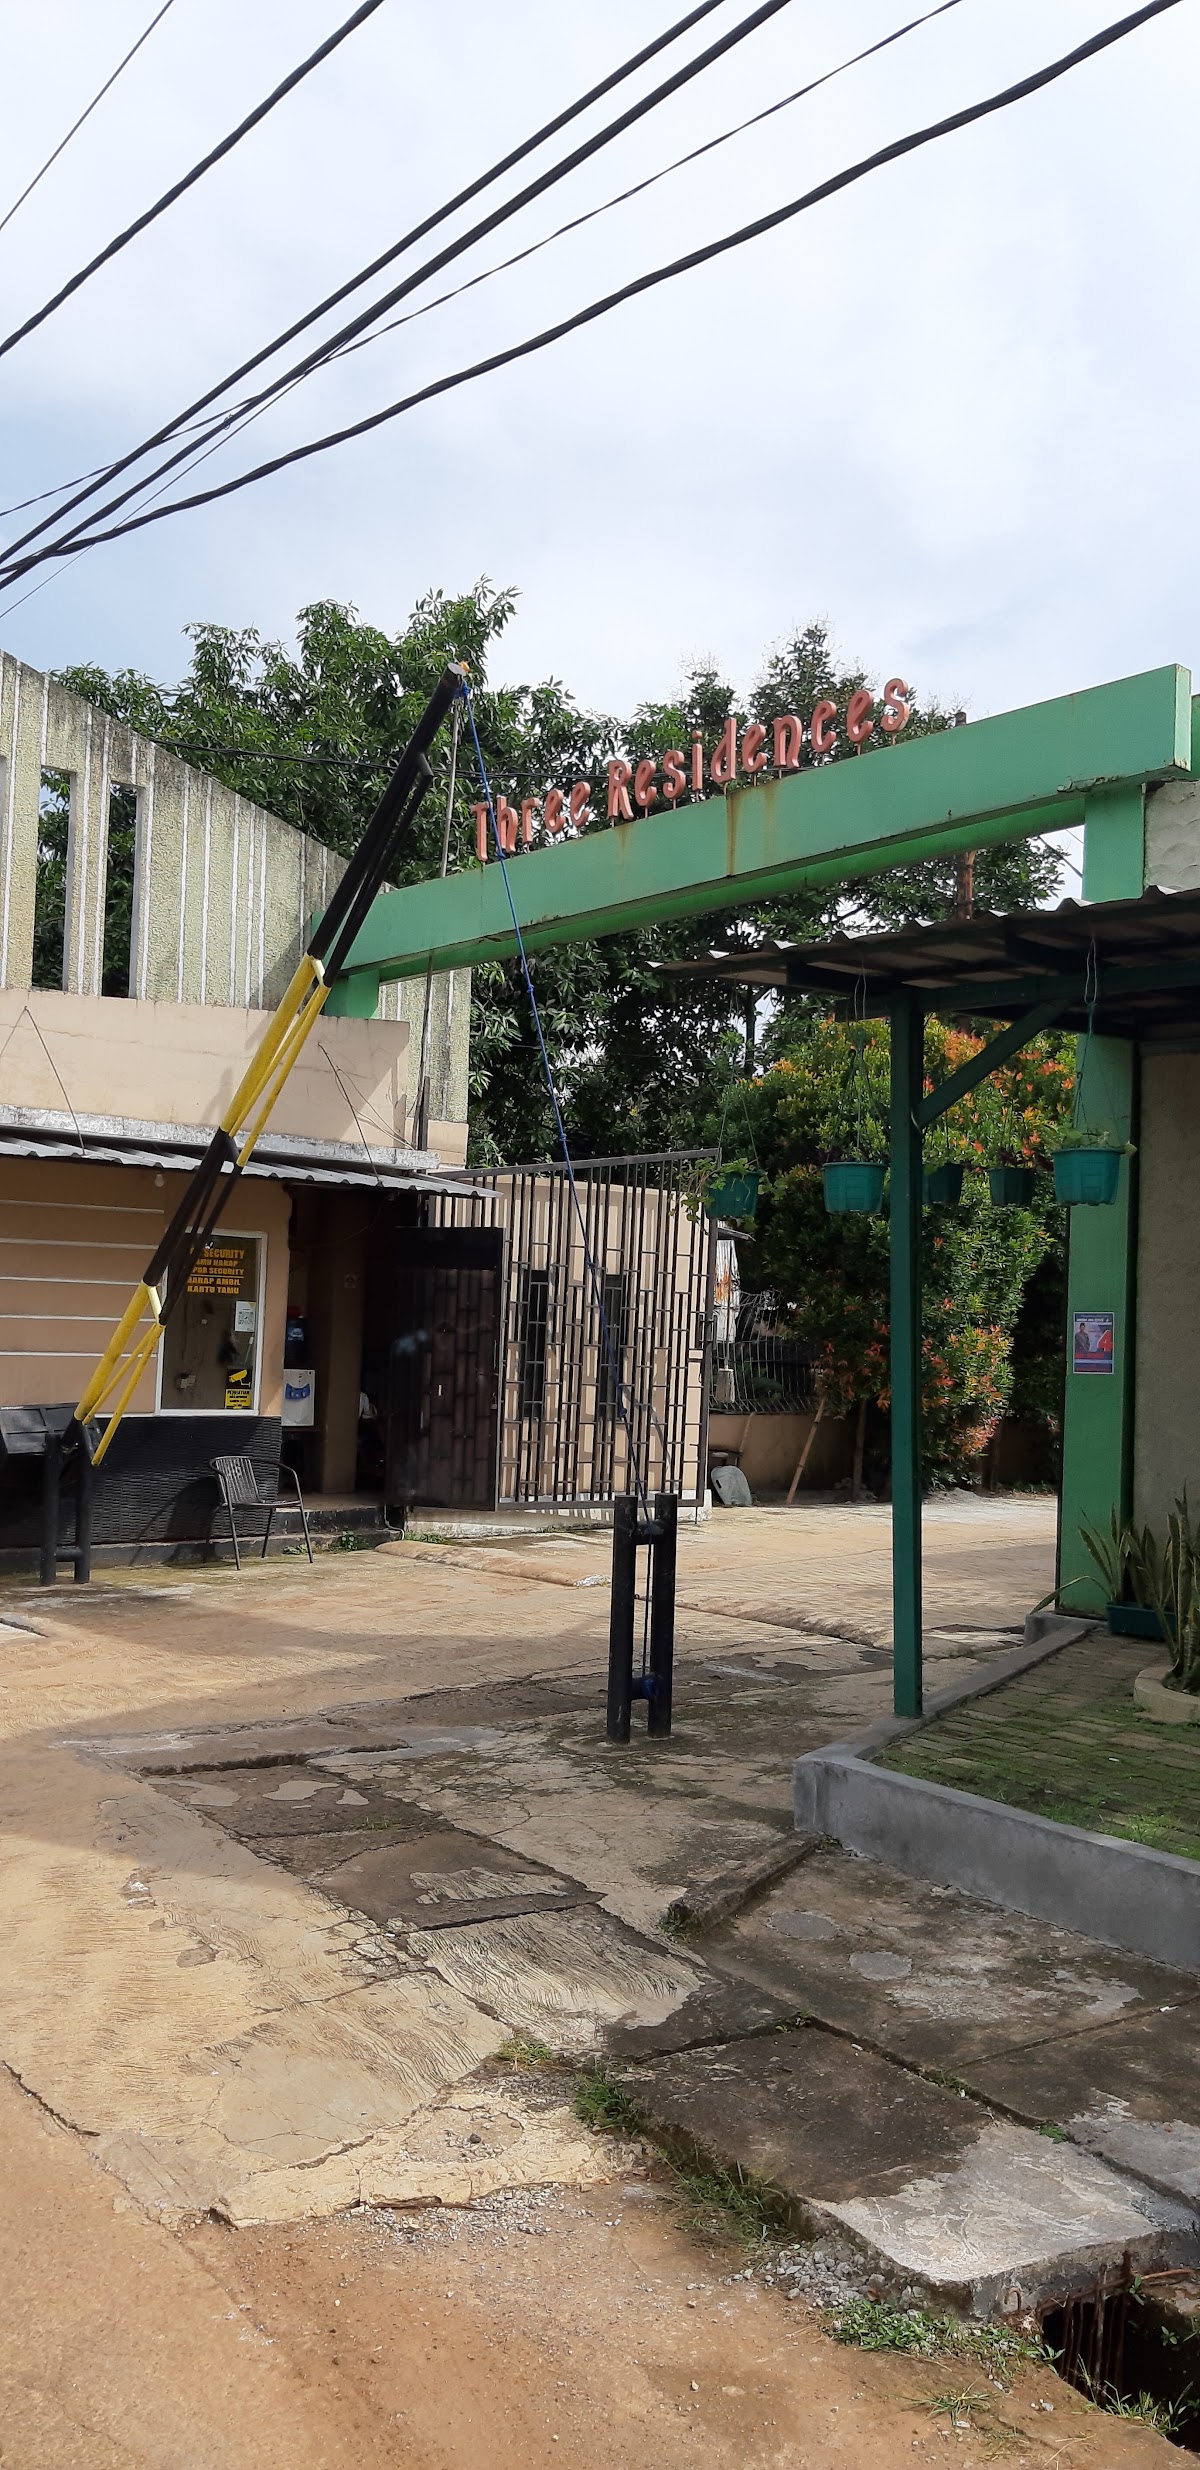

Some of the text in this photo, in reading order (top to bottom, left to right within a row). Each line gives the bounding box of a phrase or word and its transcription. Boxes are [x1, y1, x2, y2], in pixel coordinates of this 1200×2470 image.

[470, 677, 910, 863] Three Residences
[203, 1248, 245, 1259] SECURITY
[196, 1258, 212, 1266] AMU
[192, 1266, 245, 1276] POR SECURITY
[216, 1286, 240, 1294] TAMU
